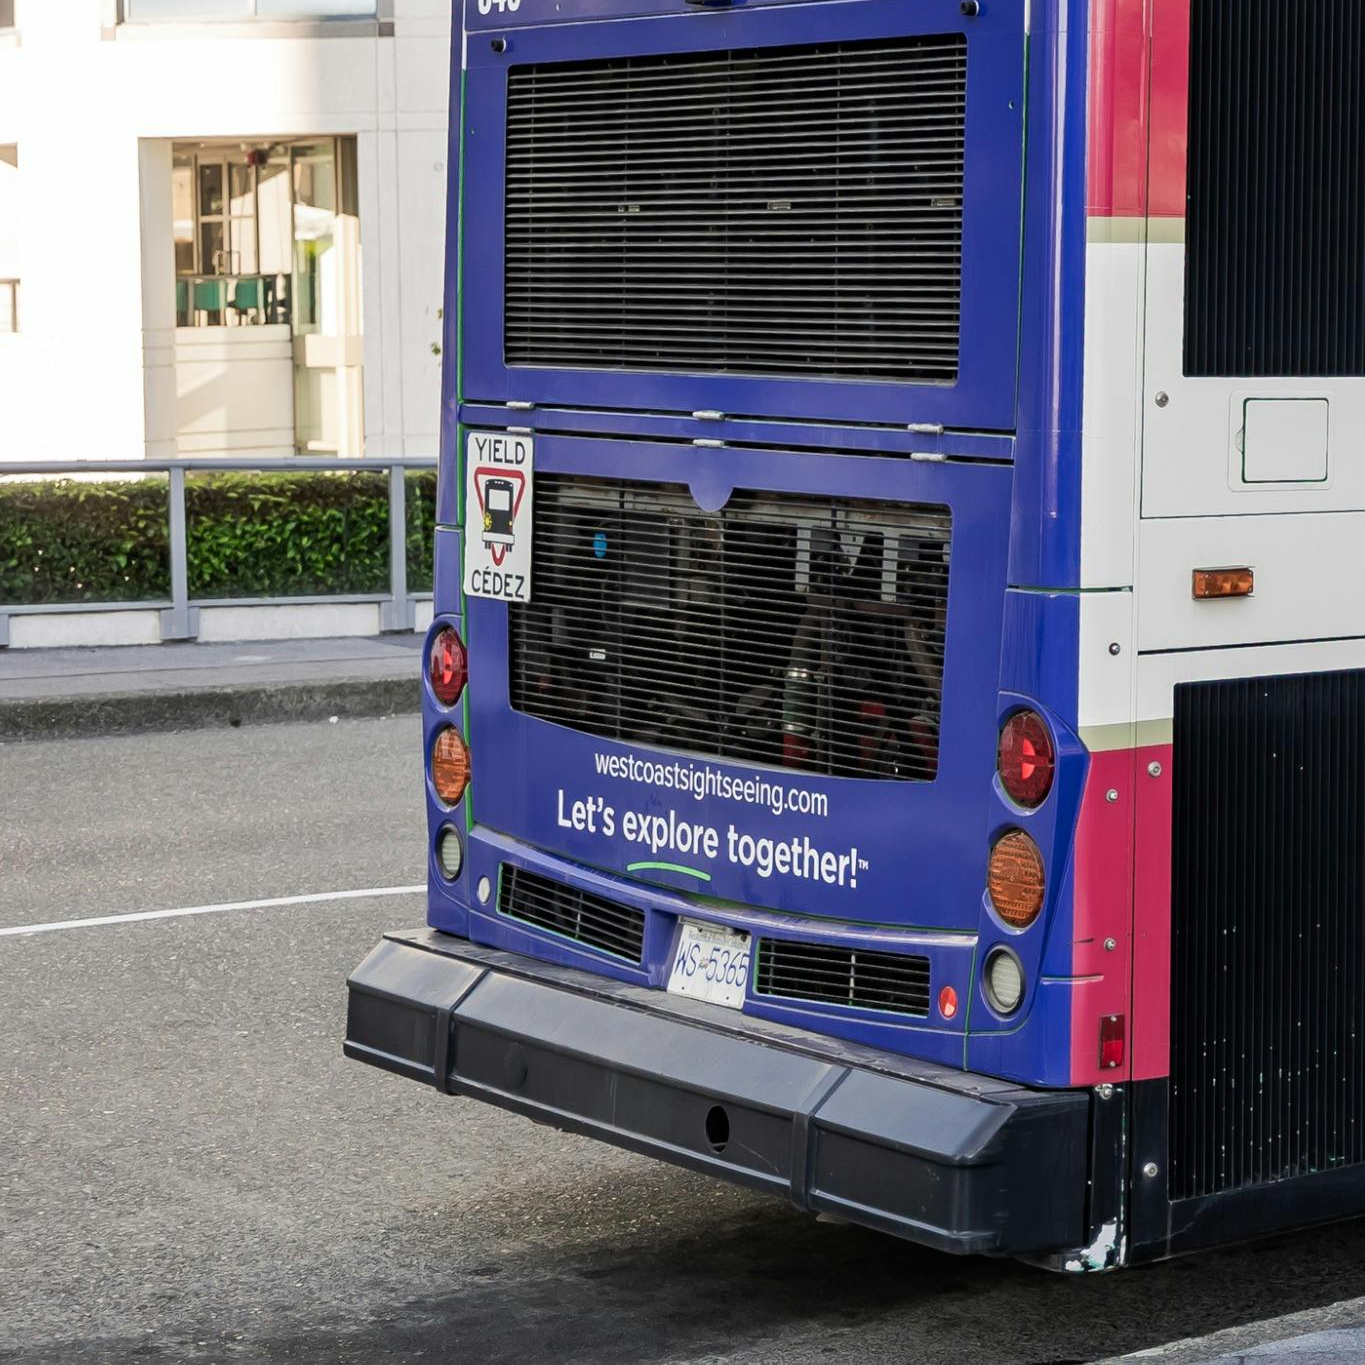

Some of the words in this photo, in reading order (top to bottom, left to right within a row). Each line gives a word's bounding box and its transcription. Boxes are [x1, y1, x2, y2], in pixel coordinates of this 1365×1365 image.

[475, 436, 526, 465] YIELD
[471, 566, 526, 600] CÉDEZ
[595, 752, 828, 817] westcoastsightseeing.com
[557, 789, 615, 839] Let's
[623, 808, 718, 859] explore
[674, 941, 701, 977] WS
[706, 946, 750, 987] 5365
